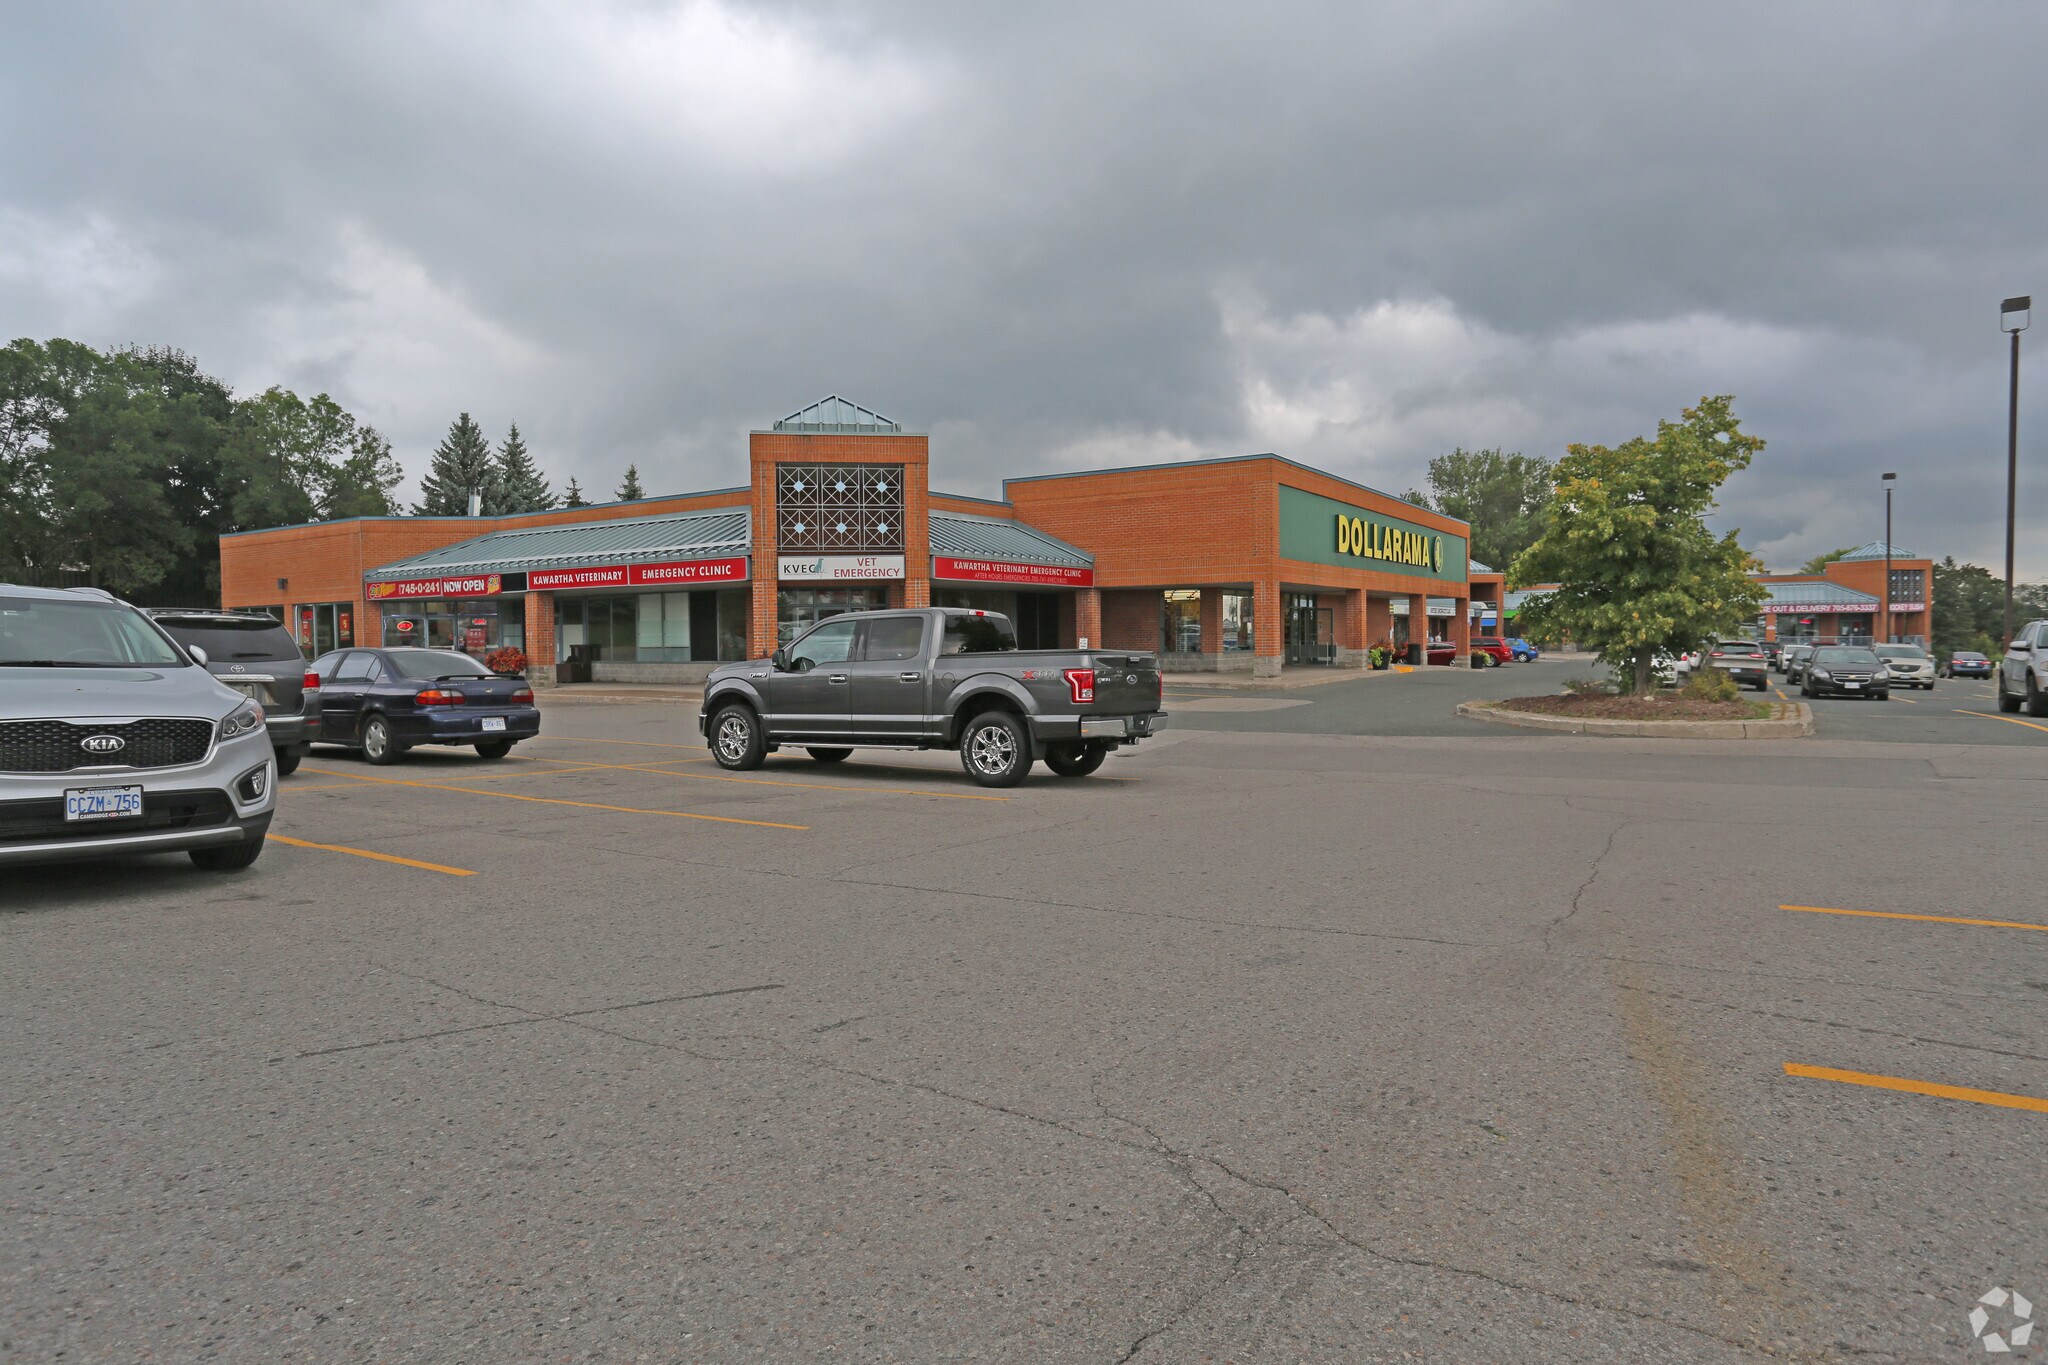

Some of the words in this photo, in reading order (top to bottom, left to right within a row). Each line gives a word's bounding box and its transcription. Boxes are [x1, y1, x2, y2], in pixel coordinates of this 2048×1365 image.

[1336, 514, 1430, 567] DOLLARAMA
[857, 557, 877, 566] VET
[783, 564, 816, 574] KVEC
[834, 568, 900, 578] EMERGENCY
[953, 561, 991, 572] KAWARTHA
[992, 564, 1028, 574] VETERINARY
[1030, 567, 1063, 576] EMERGENCY
[533, 574, 573, 585] KAWARTHA
[575, 571, 623, 582] VETERINARY
[642, 567, 696, 579] EMERGENCY
[699, 565, 731, 576] CLINIC
[1004, 574, 1031, 582] EMERGENCIES
[443, 580, 461, 593] NOW
[463, 579, 485, 592] OPEN
[89, 739, 119, 750] KIA
[68, 796, 104, 814] CCZM
[114, 794, 140, 811] 756
